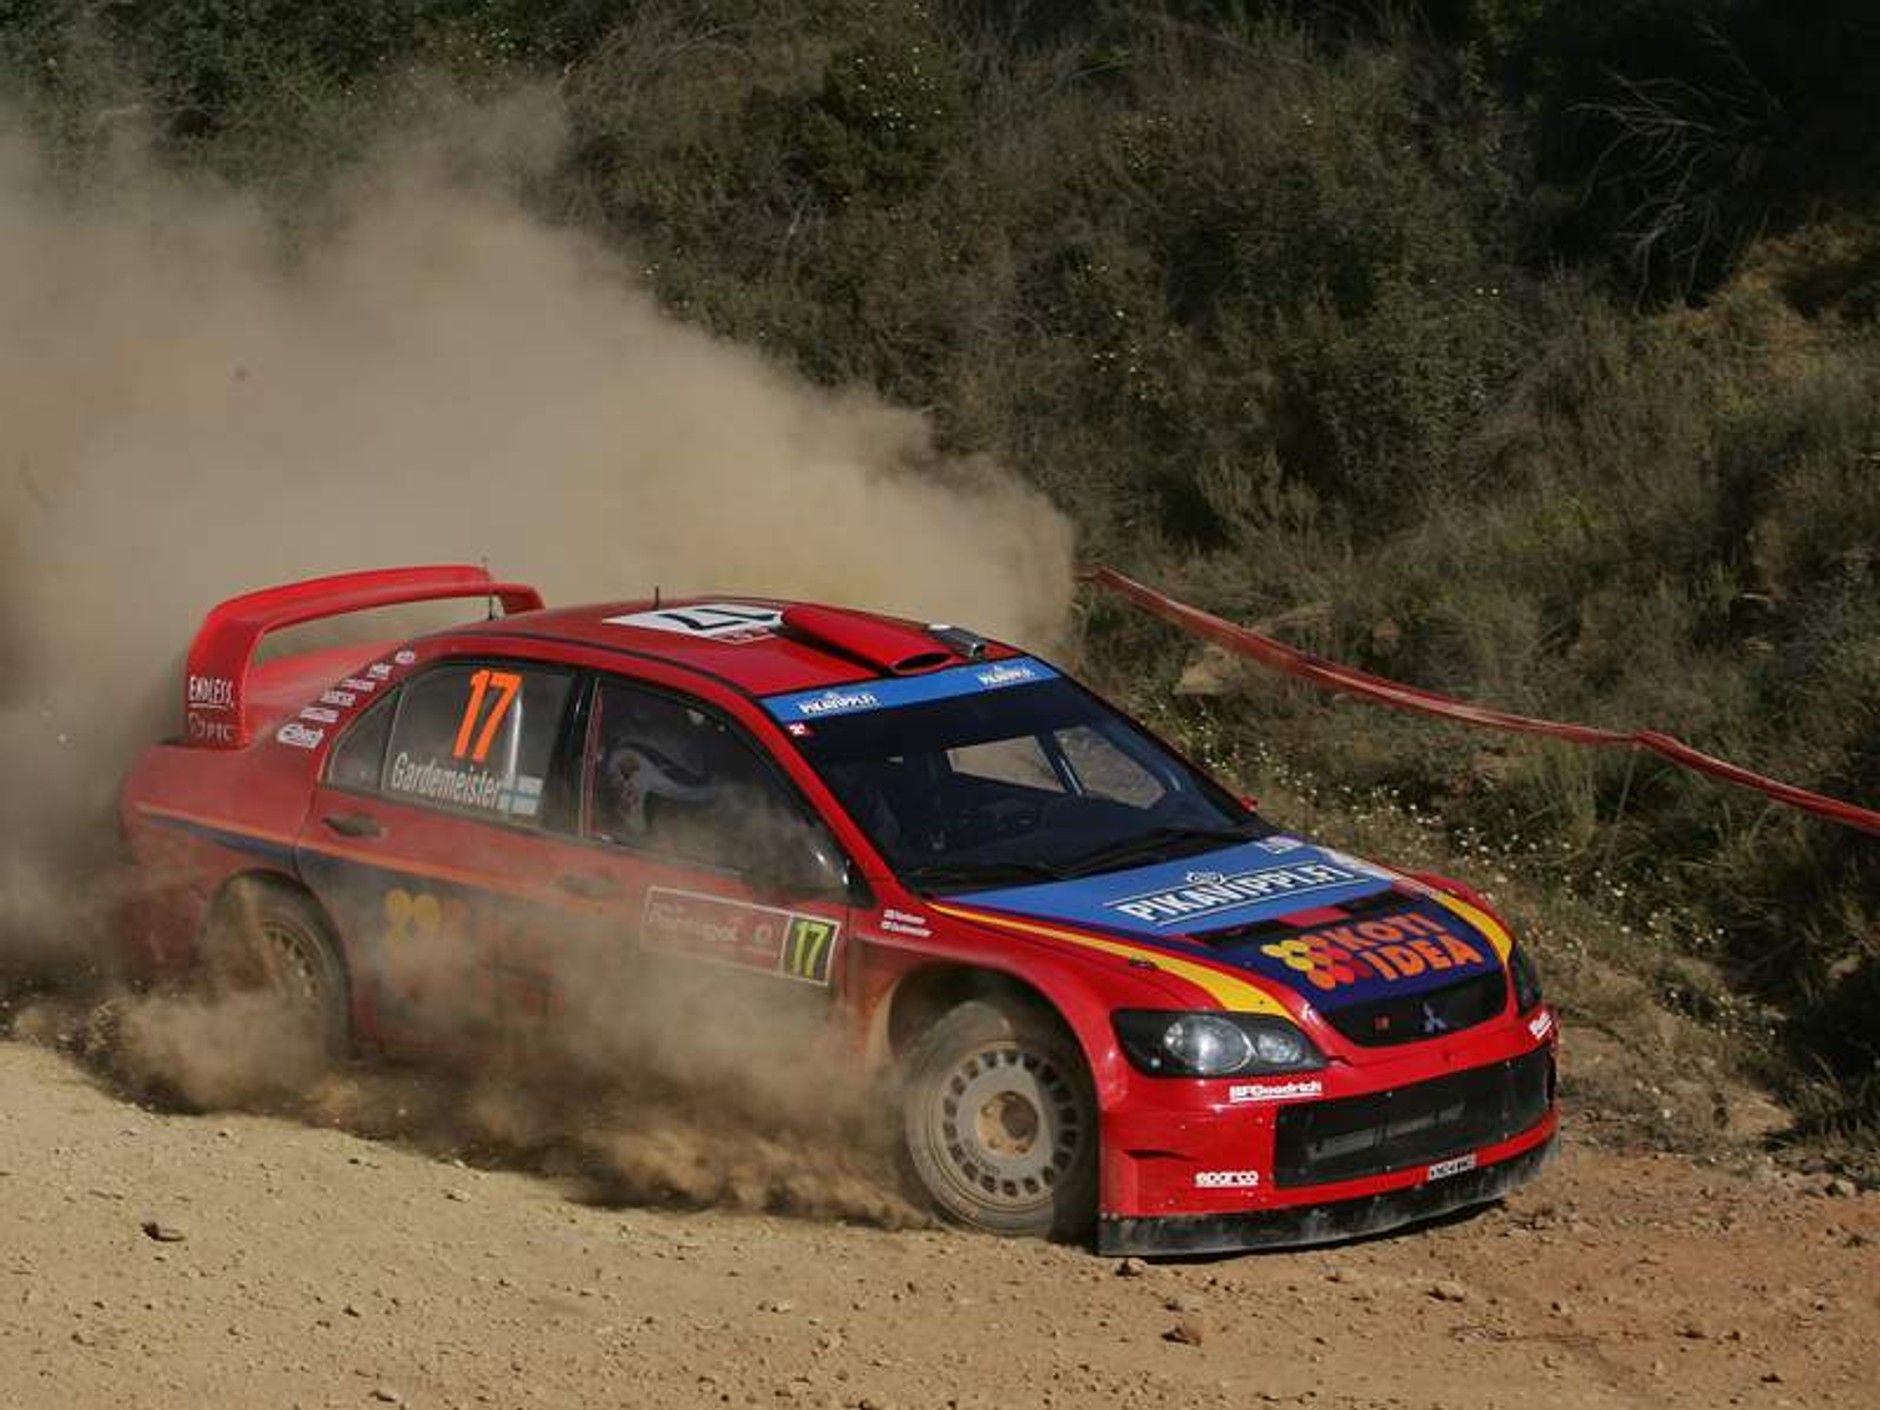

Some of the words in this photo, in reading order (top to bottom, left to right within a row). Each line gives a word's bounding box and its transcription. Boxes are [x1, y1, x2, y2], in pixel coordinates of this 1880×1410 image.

[453, 669, 523, 762] 17
[392, 752, 503, 809] Gardemeister
[793, 920, 829, 978] 17
[1323, 912, 1447, 951] KOTI
[1359, 934, 1485, 981] IDEA
